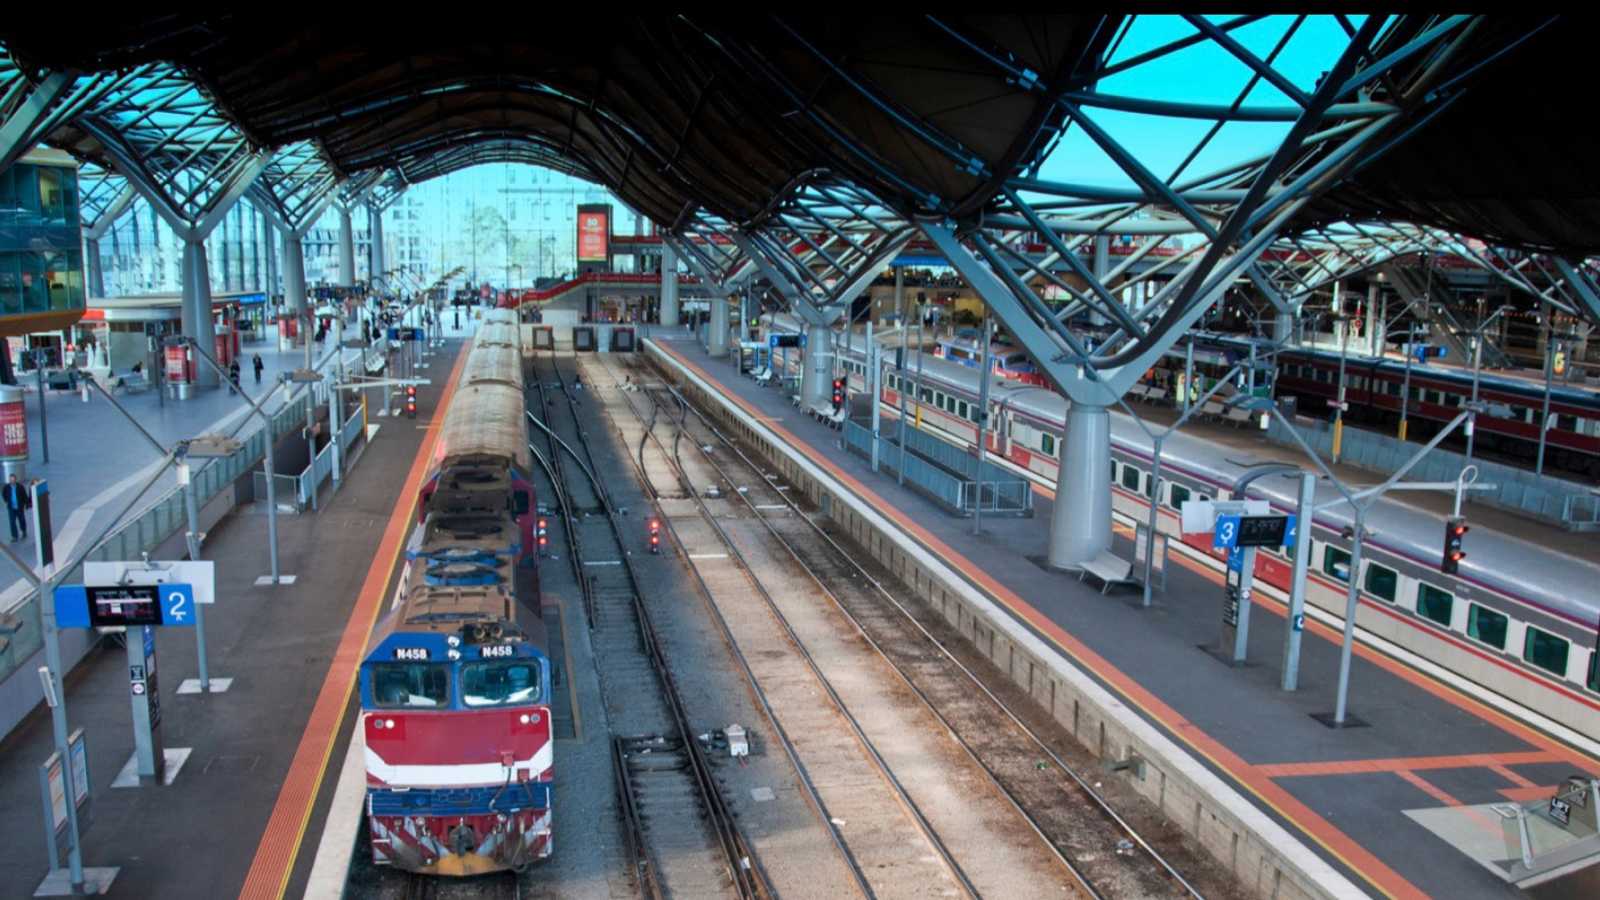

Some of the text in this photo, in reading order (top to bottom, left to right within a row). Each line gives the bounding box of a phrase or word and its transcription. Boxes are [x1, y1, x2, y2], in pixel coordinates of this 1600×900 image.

[1220, 522, 1235, 540] 3
[168, 592, 187, 615] 2
[397, 648, 427, 659] N458
[483, 646, 513, 657] N458
[1552, 797, 1569, 812] LIFT
